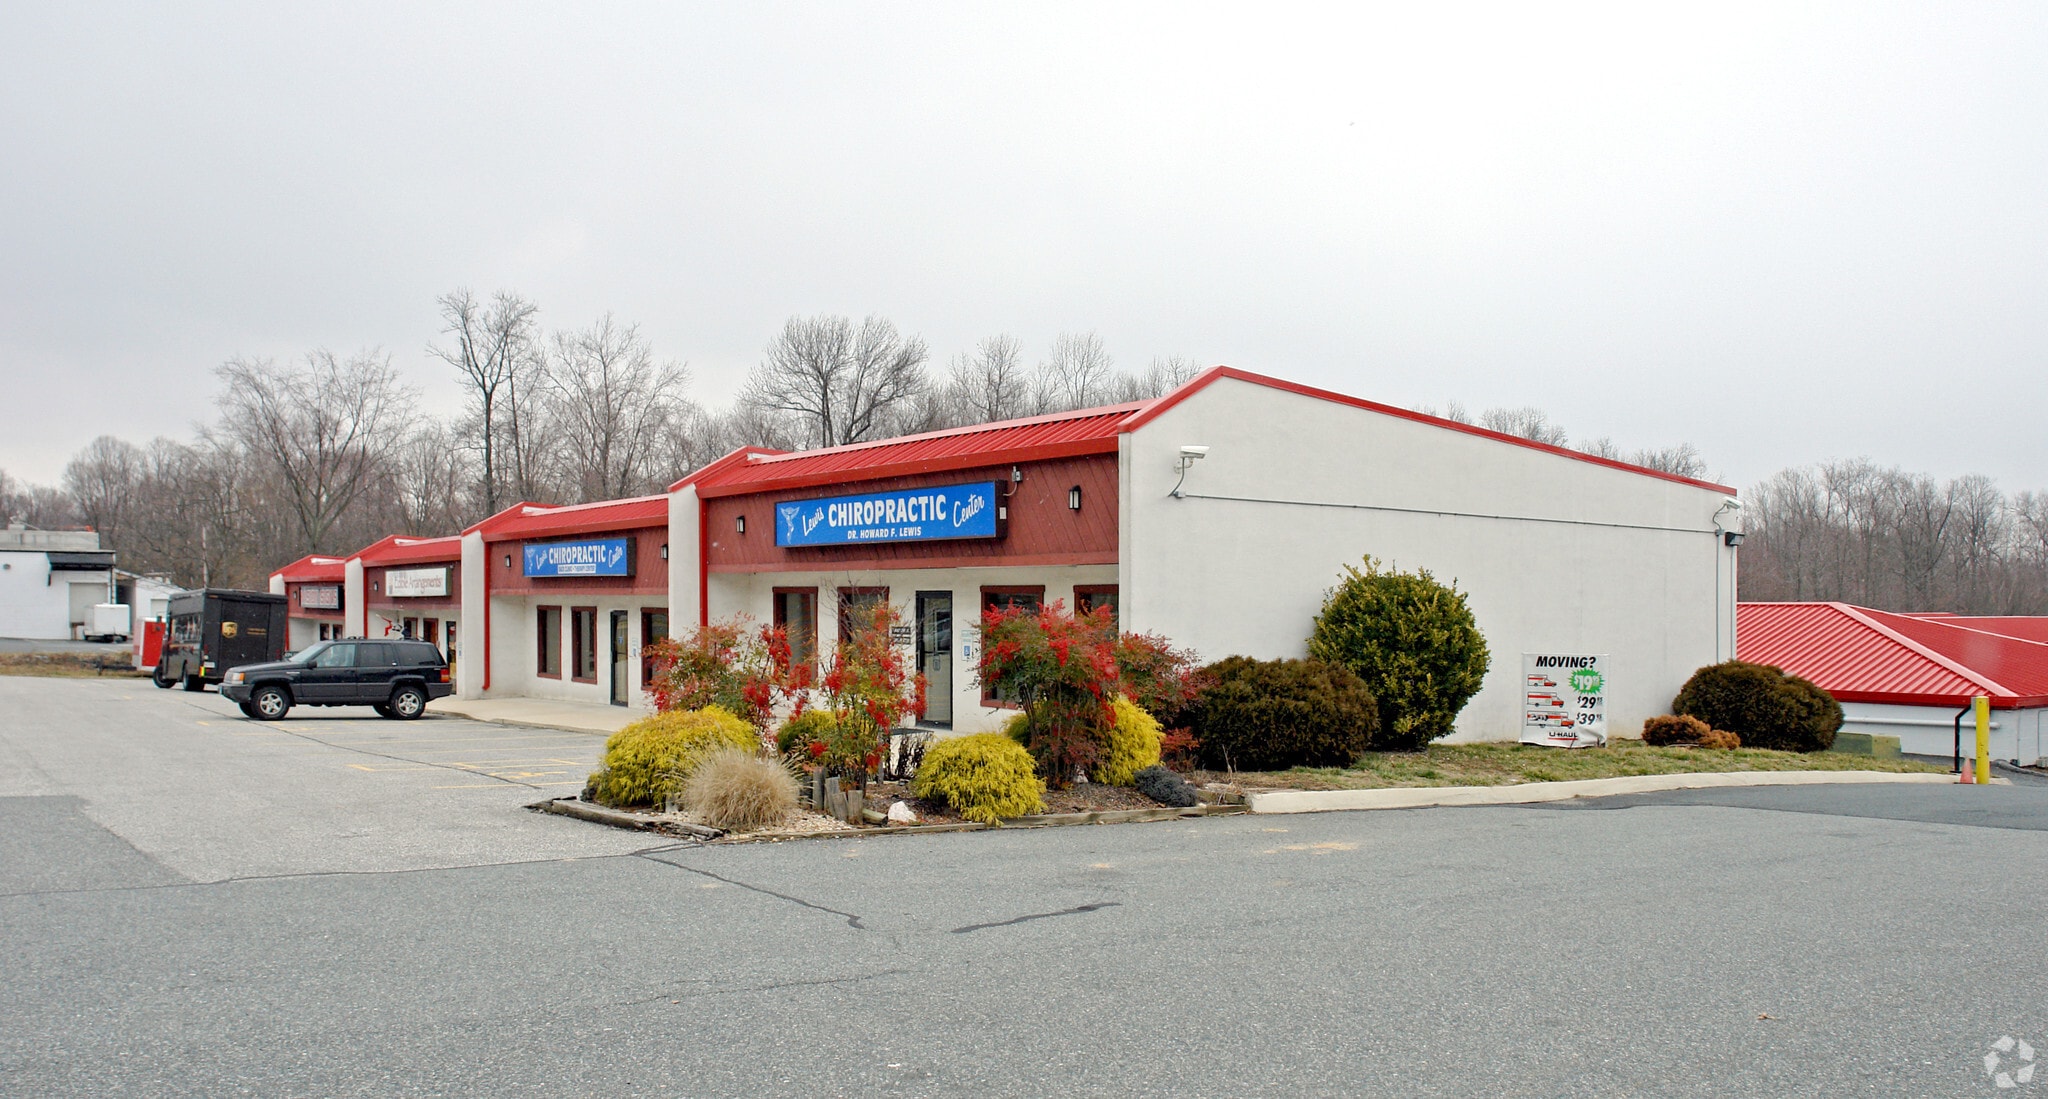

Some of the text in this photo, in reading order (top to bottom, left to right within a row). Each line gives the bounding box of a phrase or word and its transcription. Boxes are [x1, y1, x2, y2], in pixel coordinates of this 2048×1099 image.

[802, 493, 985, 537] Lewis CHIROPRACTIC Center
[847, 526, 922, 540] DR. HOWARD F. LEWIS
[549, 545, 606, 564] CHIROPRACTIC
[1536, 656, 1596, 668] MOVING?
